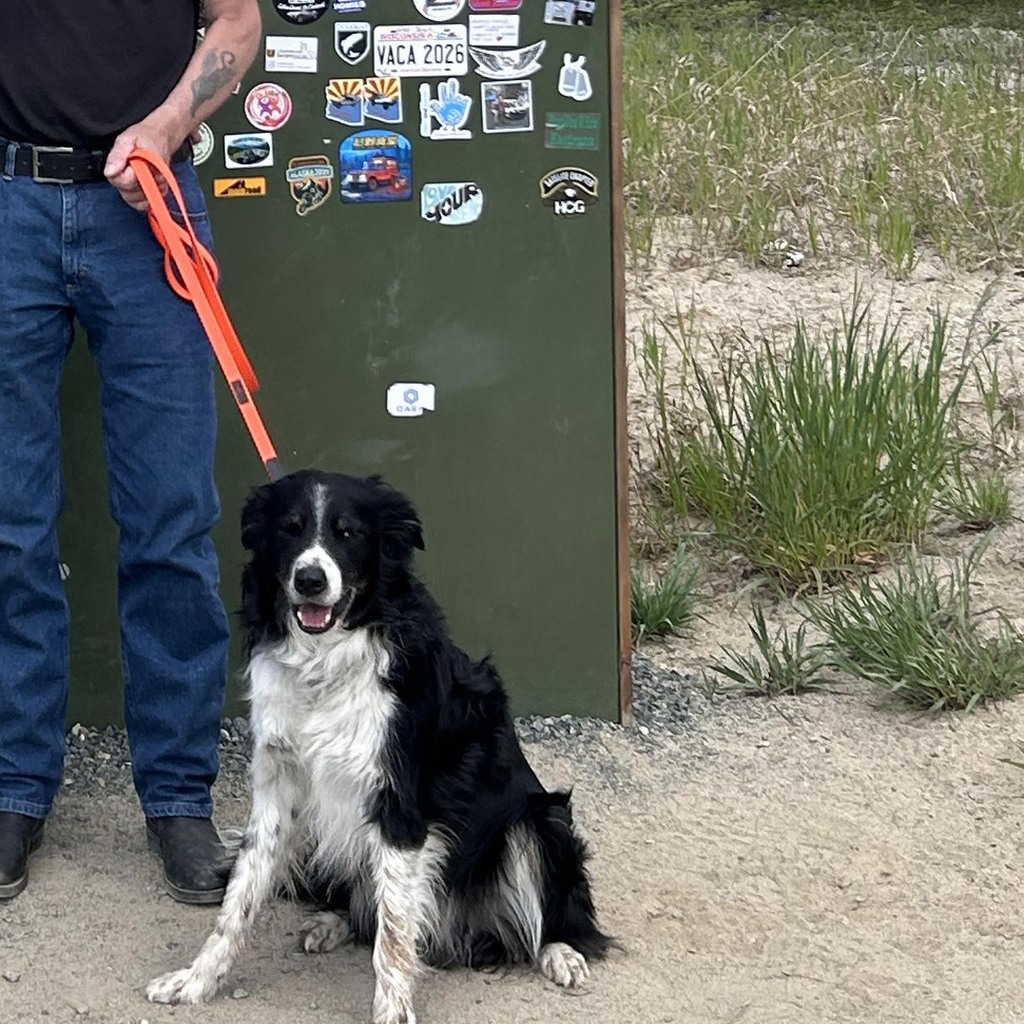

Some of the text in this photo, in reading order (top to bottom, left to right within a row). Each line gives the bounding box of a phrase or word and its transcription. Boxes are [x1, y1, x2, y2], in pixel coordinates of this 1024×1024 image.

[377, 43, 465, 66] VACA 2026
[425, 184, 479, 222] YOUR
[555, 200, 585, 214] HOG
